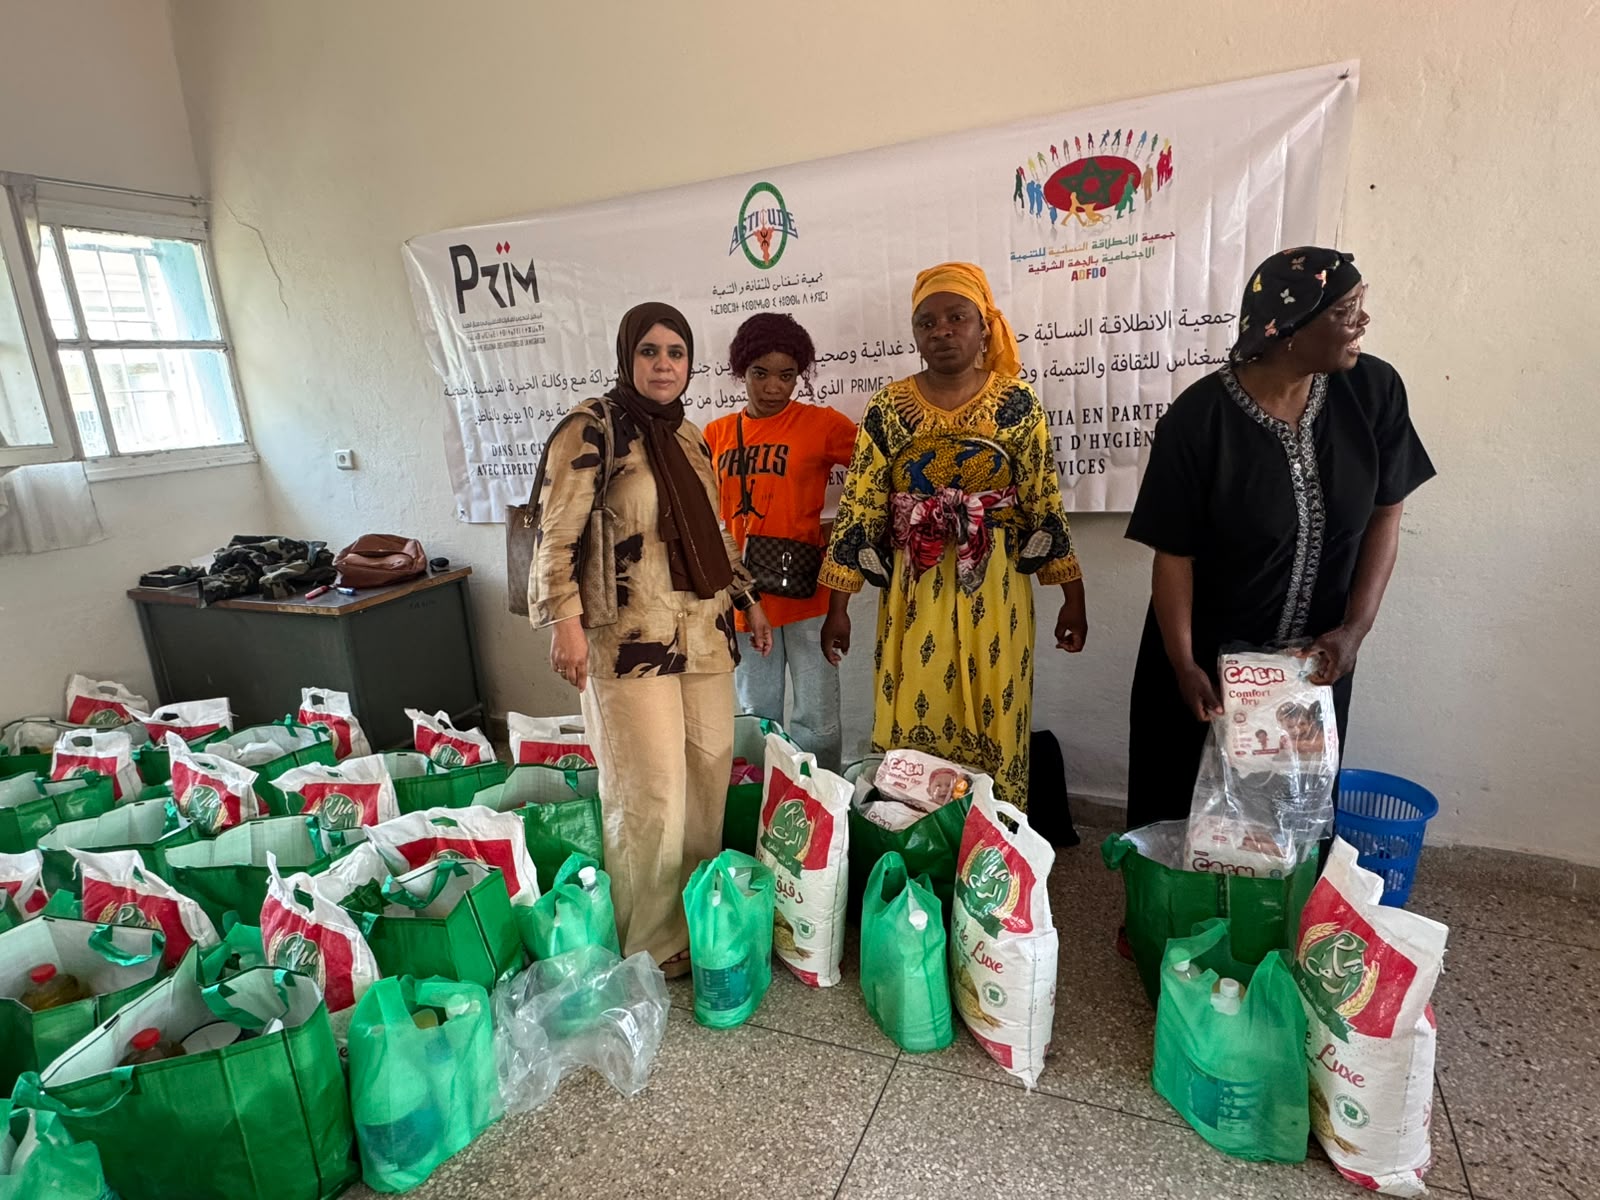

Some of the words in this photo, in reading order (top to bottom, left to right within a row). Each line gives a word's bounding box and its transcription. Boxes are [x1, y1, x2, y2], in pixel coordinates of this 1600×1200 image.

[1091, 233, 1139, 250] الانطلاقة
[1141, 231, 1176, 245] جمعية
[1010, 247, 1046, 263] للتنمية
[1068, 255, 1099, 268] بالجهة
[1102, 246, 1155, 264] الاجتماعية
[1028, 260, 1064, 275] الشرقية
[1071, 267, 1107, 282] ADFDO
[801, 272, 823, 288] جمعية
[712, 282, 738, 299] التنمية
[1099, 310, 1172, 335] الانطلاقة
[1178, 308, 1237, 332] جمعية
[1034, 318, 1093, 346] النسائية
[815, 349, 857, 368] وصحي
[1110, 350, 1160, 372] للثقافة
[508, 375, 539, 396] الخبرة
[541, 373, 568, 391] وكالة
[570, 377, 587, 392] مع
[589, 368, 619, 387] شراكة
[715, 388, 749, 408] تمويل
[817, 378, 844, 403] الذي
[697, 395, 712, 409] من
[523, 406, 534, 420] 10
[537, 409, 555, 422] يوم
[1082, 407, 1103, 424] EN
[1070, 428, 1156, 451] D'HYGIÈN
[516, 443, 528, 456] LE
[476, 463, 500, 476] AVEC
[502, 462, 539, 476] EXPERT
[718, 444, 790, 483] PARIS
[1057, 458, 1106, 477] VICES
[1229, 689, 1271, 699] Comfort
[970, 940, 1004, 974] Luxe
[1315, 1043, 1366, 1088] Luxe
